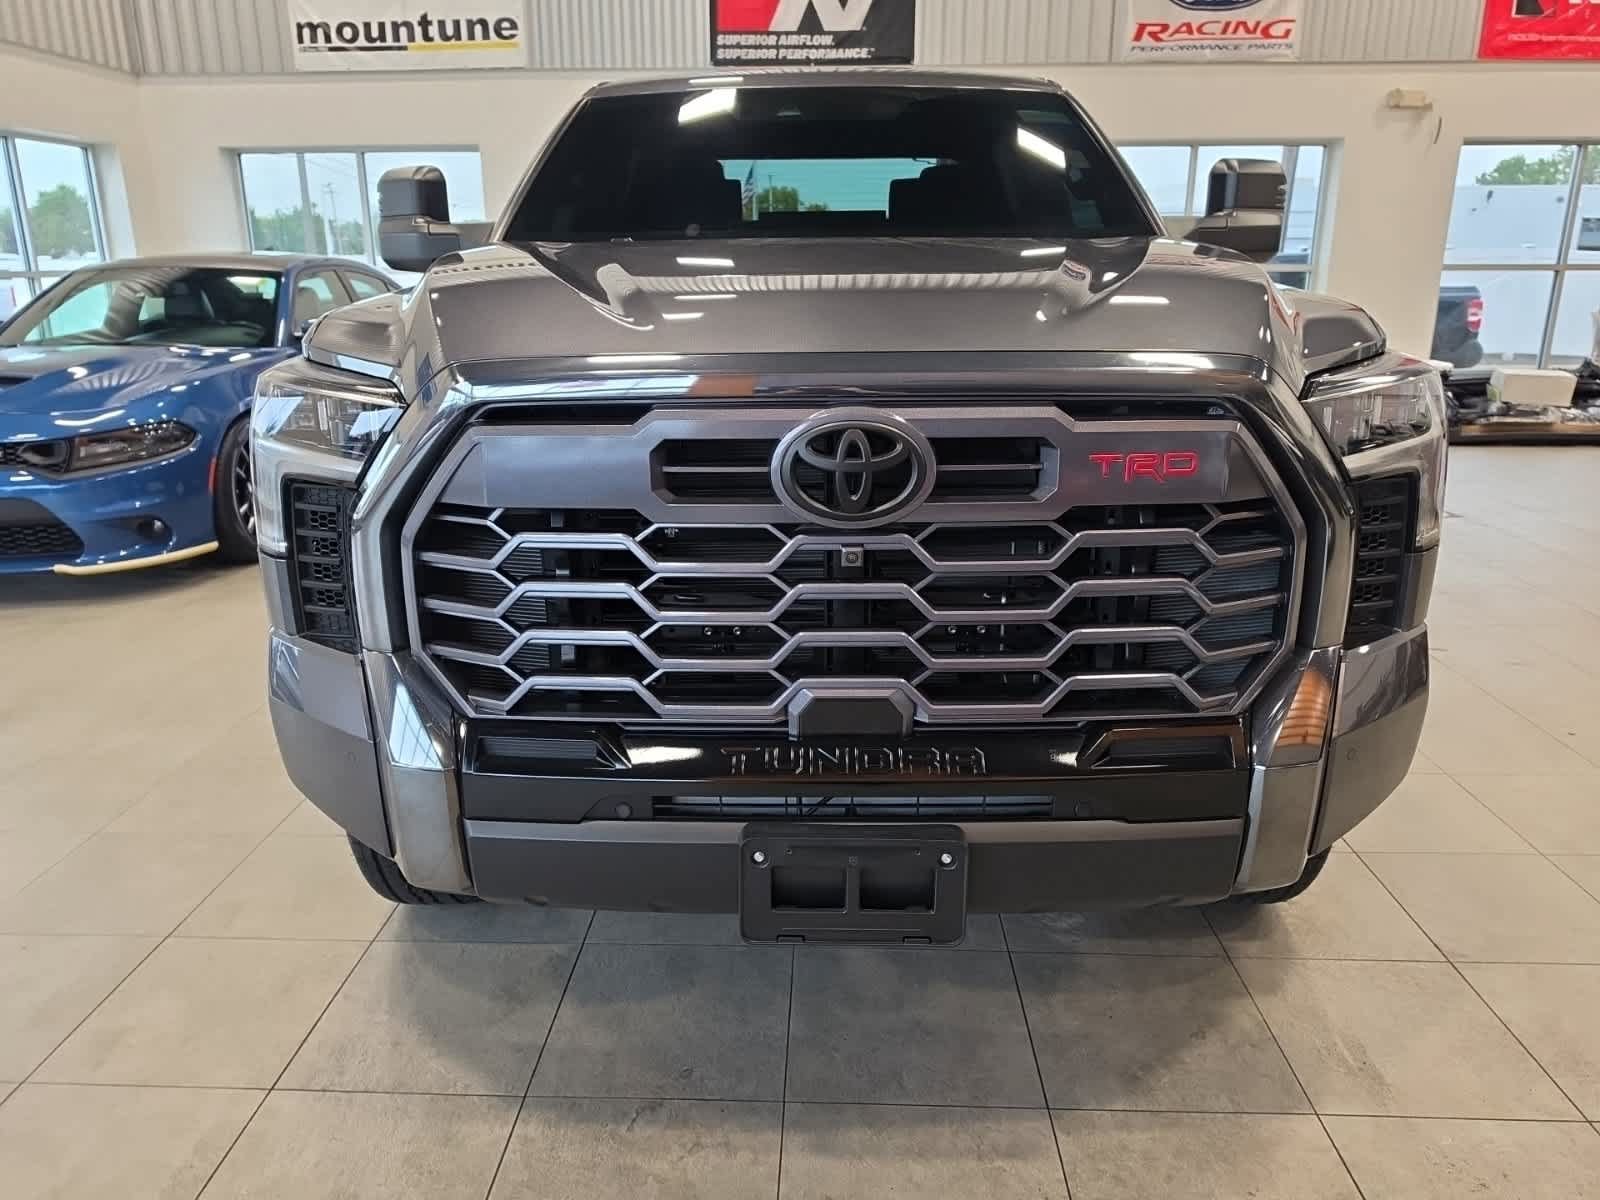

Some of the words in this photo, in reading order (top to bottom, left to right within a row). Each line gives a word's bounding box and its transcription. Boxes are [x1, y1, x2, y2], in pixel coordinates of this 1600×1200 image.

[296, 12, 519, 44] mountune
[716, 34, 778, 46] SUPERIOR
[778, 34, 835, 46] AIRFLOW.
[1132, 19, 1296, 42] RACING
[716, 48, 778, 59] SUPERIOR
[1089, 450, 1199, 484] TRD
[720, 746, 987, 776] TUNDRA
